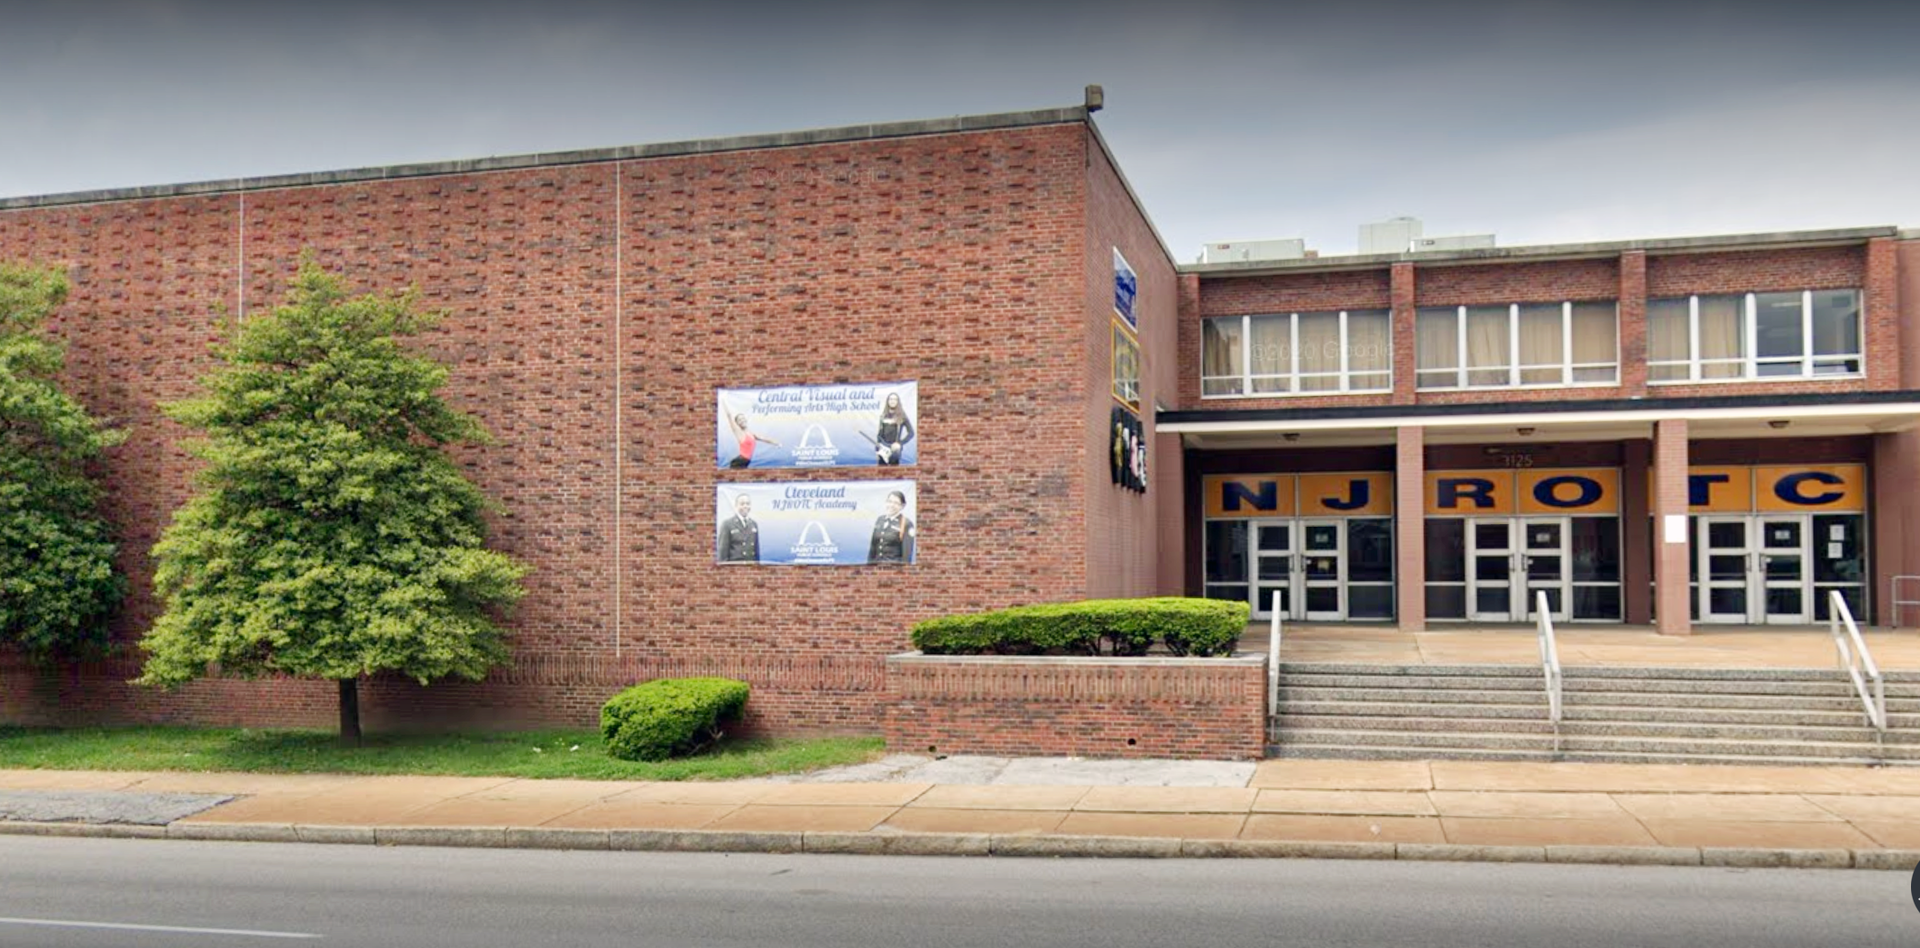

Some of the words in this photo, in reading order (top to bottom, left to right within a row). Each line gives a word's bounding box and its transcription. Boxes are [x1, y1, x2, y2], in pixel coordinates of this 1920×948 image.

[758, 388, 803, 403] Central
[806, 387, 847, 401] Visual
[849, 387, 875, 399] and
[751, 403, 803, 415] Performing
[804, 402, 824, 413] Arts
[824, 401, 848, 414] High
[850, 401, 880, 411] School
[785, 486, 845, 498] Cleveland
[814, 499, 857, 511] Academy
